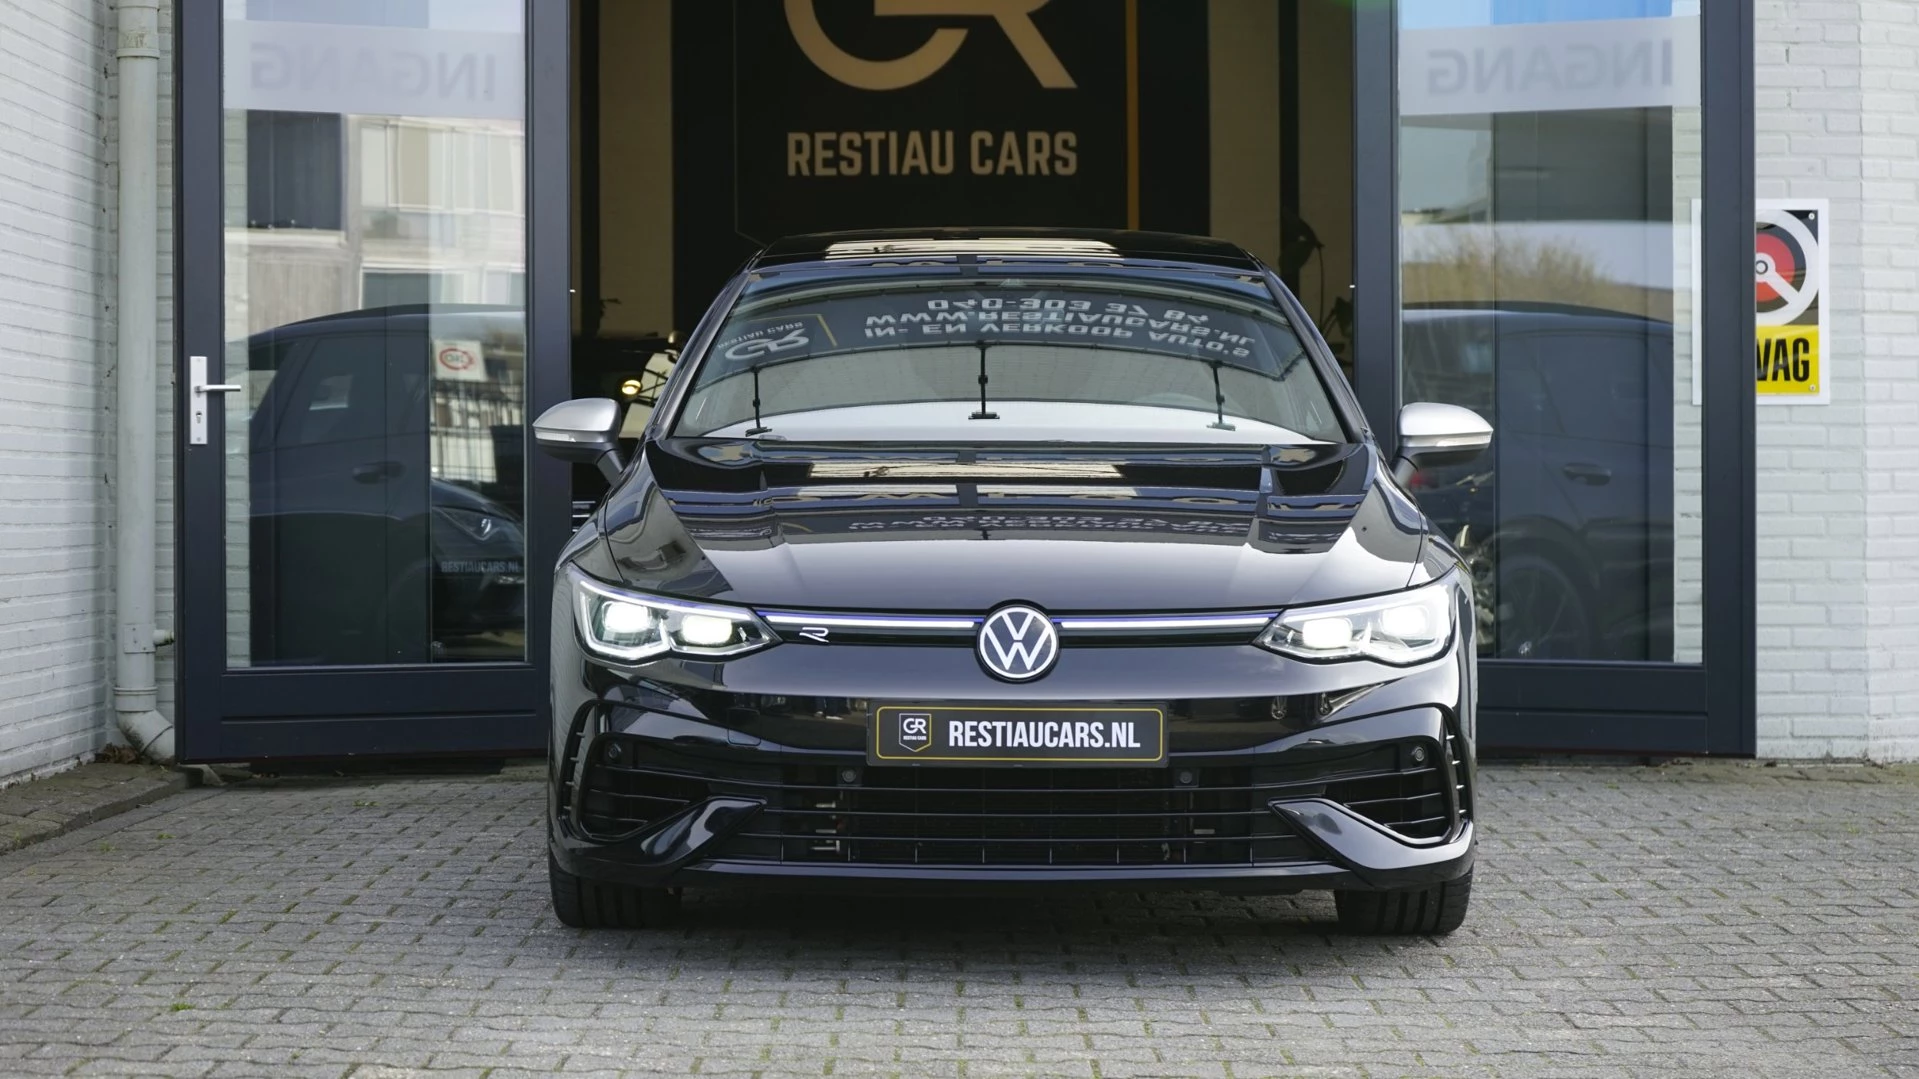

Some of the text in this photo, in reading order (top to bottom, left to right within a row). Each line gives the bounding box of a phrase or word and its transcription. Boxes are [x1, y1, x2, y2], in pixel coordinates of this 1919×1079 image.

[786, 130, 1078, 176] RESTIAU CARS
[1756, 337, 1810, 382] VAG
[949, 720, 1141, 748] RESTIAUCARS.NL
